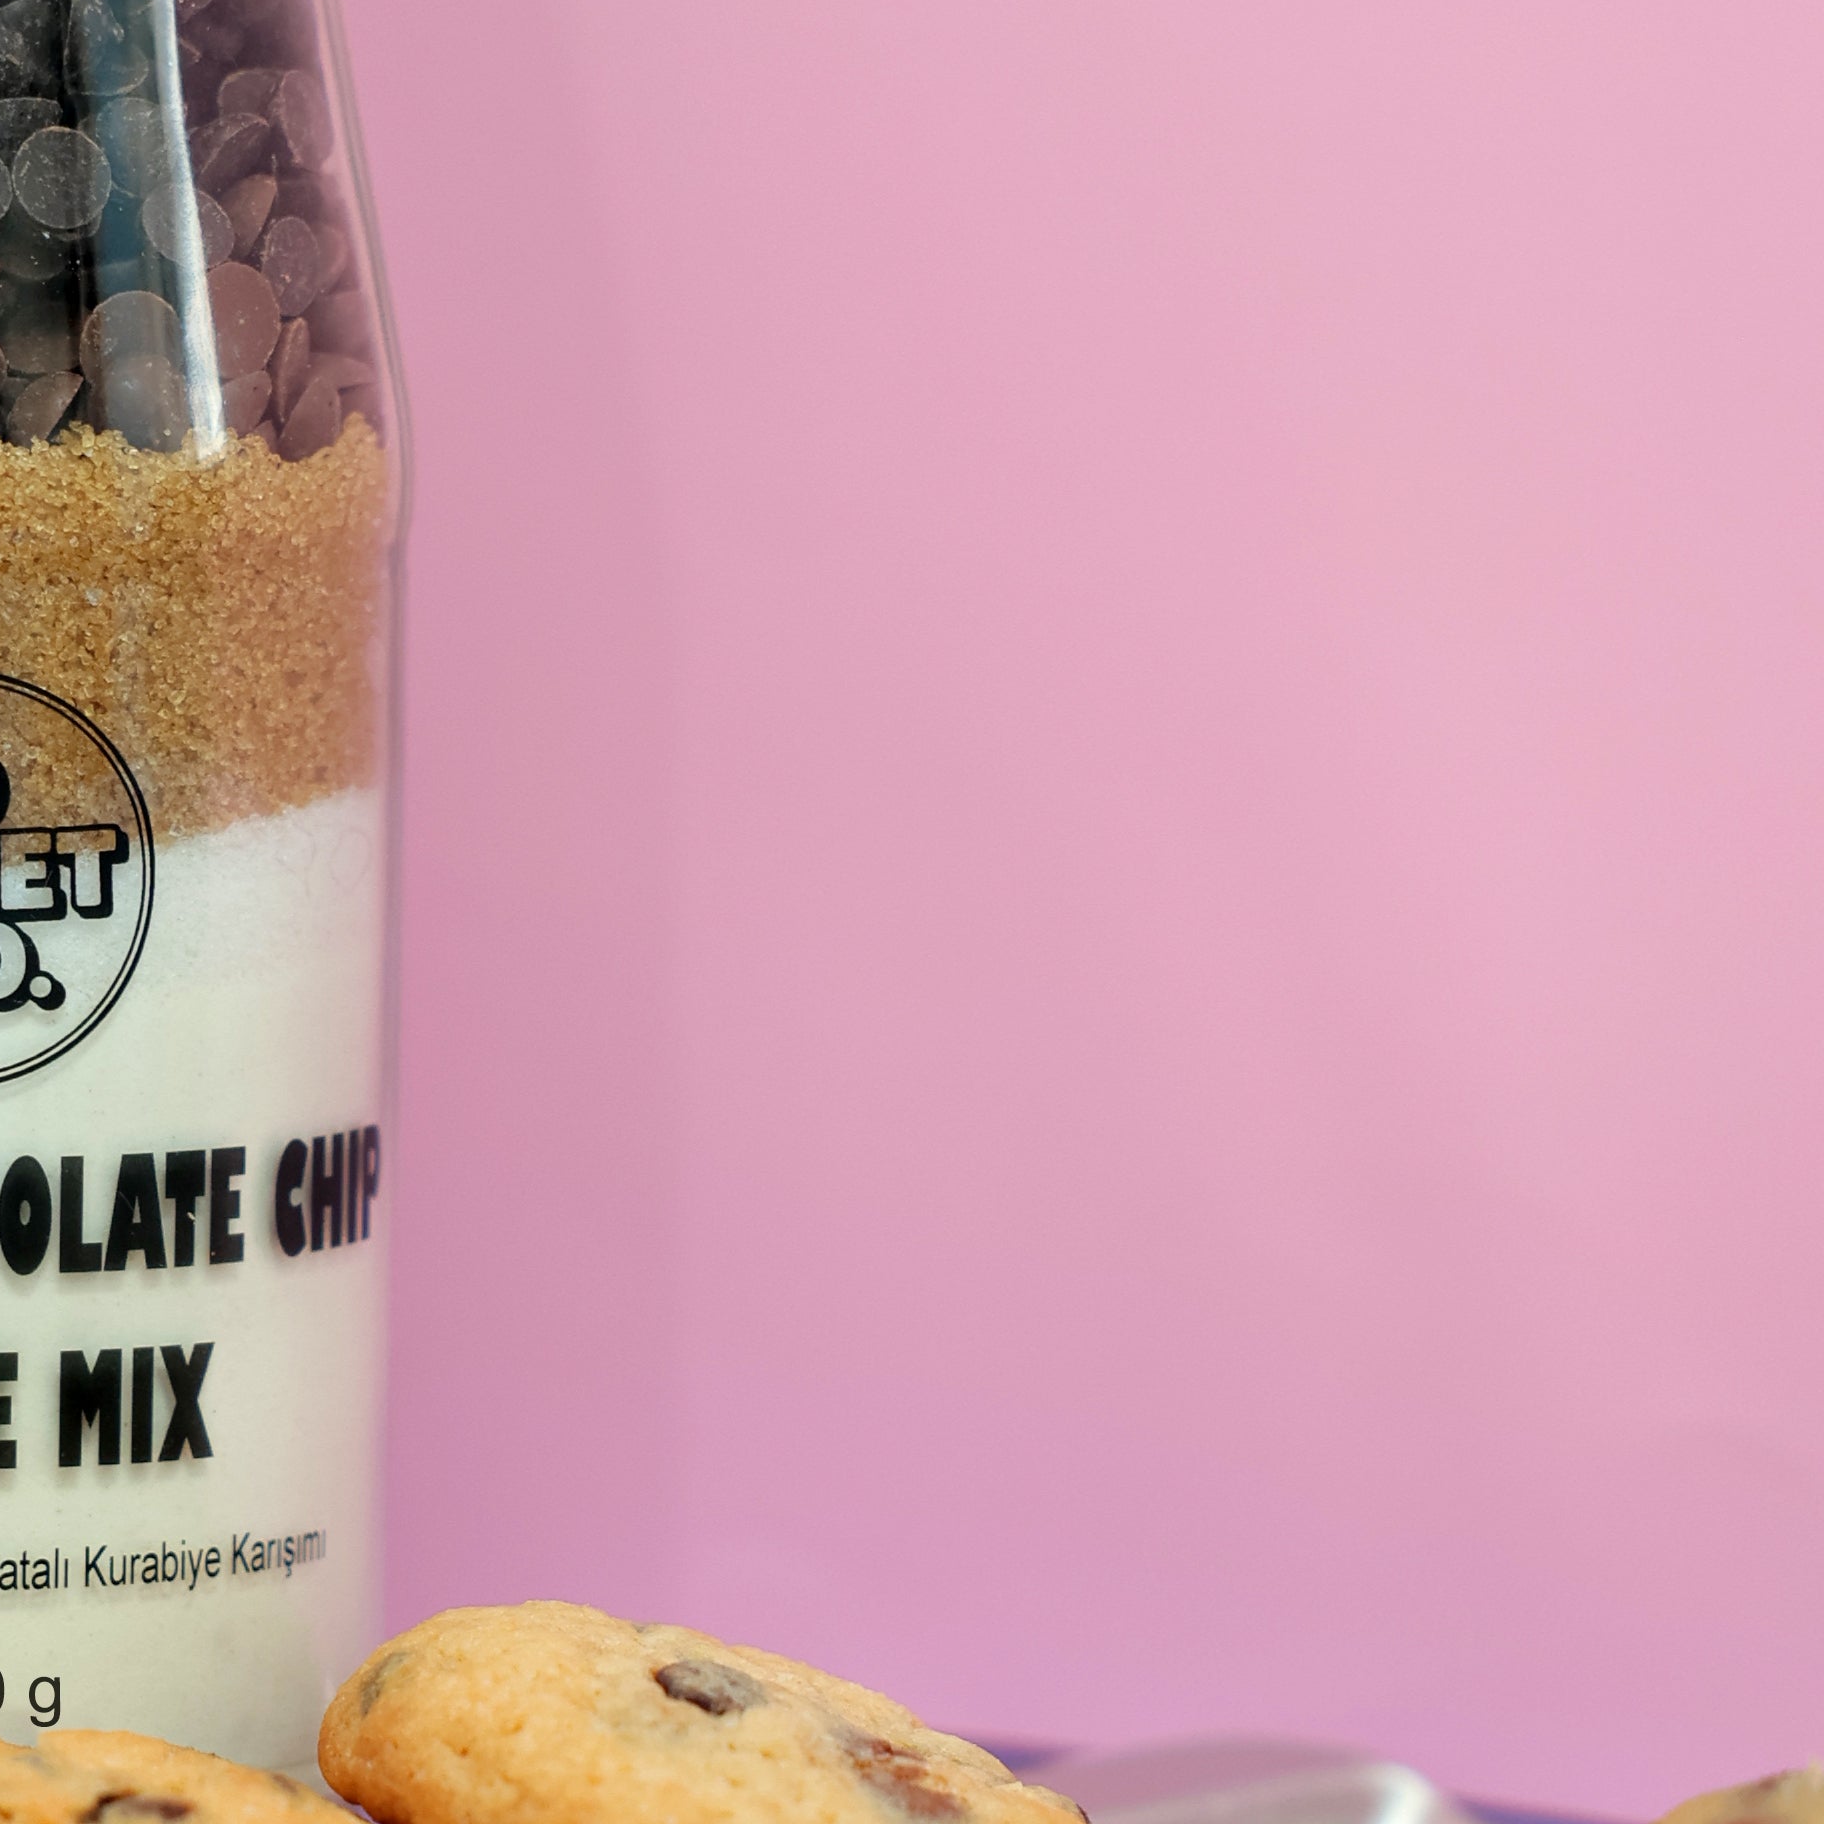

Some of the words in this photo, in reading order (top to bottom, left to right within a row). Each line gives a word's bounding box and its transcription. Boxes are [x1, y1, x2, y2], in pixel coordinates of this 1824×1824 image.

[274, 1123, 381, 1258] CHIP
[58, 1341, 216, 1468] MIX
[83, 1538, 221, 1592] Kurabiye
[230, 1527, 327, 1578] Karışımı
[28, 1674, 62, 1728] g
